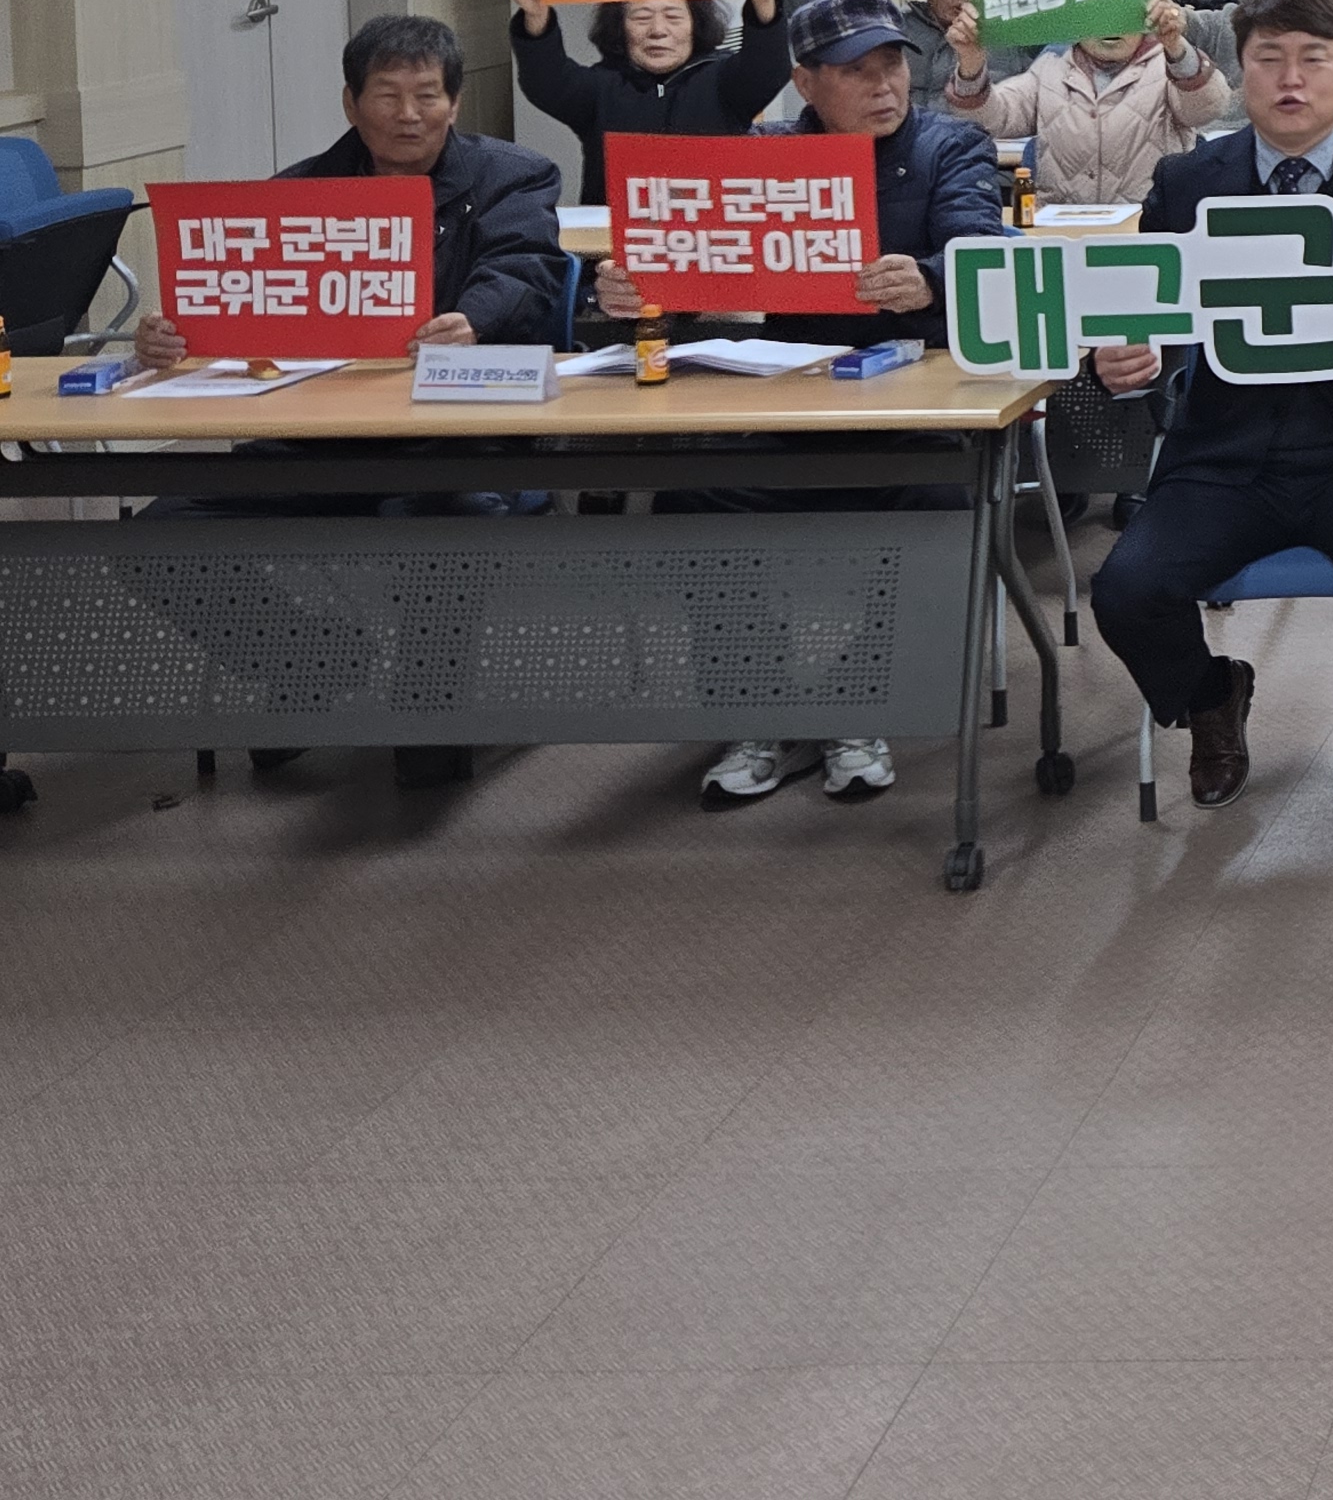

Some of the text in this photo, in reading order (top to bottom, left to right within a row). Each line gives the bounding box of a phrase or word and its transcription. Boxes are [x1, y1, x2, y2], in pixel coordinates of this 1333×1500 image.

[626, 177, 855, 224] 대구 군부대
[178, 215, 412, 262] 대구 군부대
[624, 228, 863, 275] 군위군 이전!
[174, 269, 416, 317] 군위군 이전!
